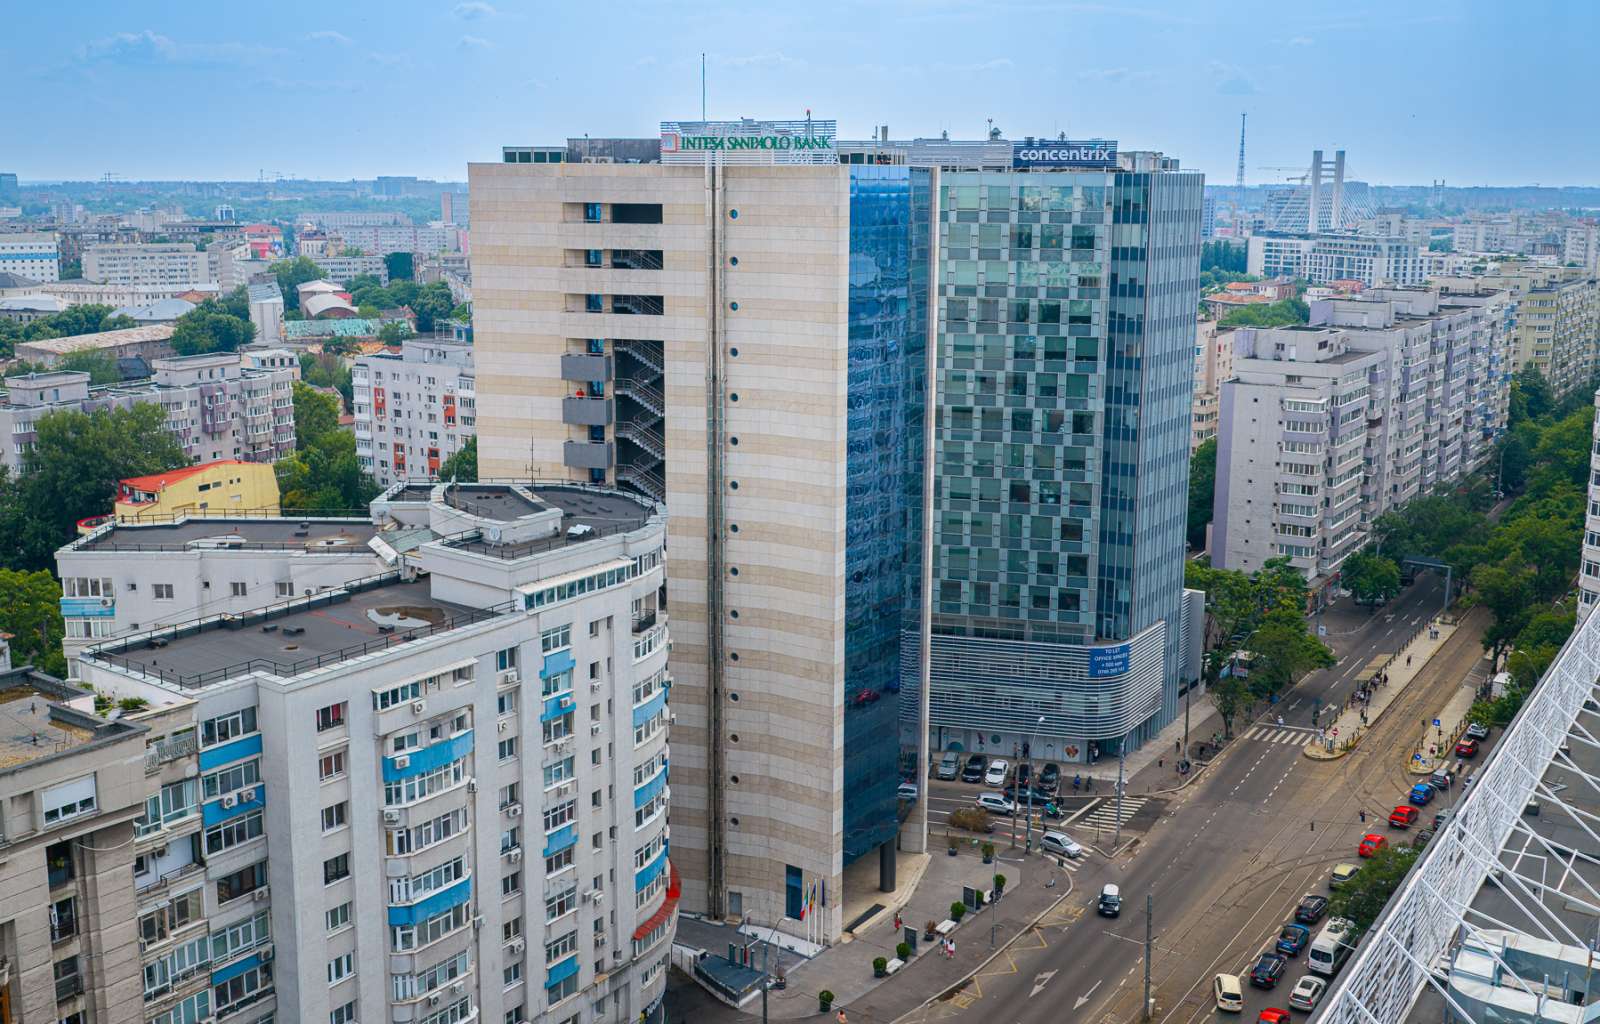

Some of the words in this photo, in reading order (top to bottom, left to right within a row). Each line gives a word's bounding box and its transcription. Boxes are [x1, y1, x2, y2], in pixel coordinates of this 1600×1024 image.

[681, 136, 725, 150] INTESA
[727, 136, 791, 150] SANPAOLO
[793, 136, 832, 150] BANK
[1020, 146, 1111, 161] concentrix
